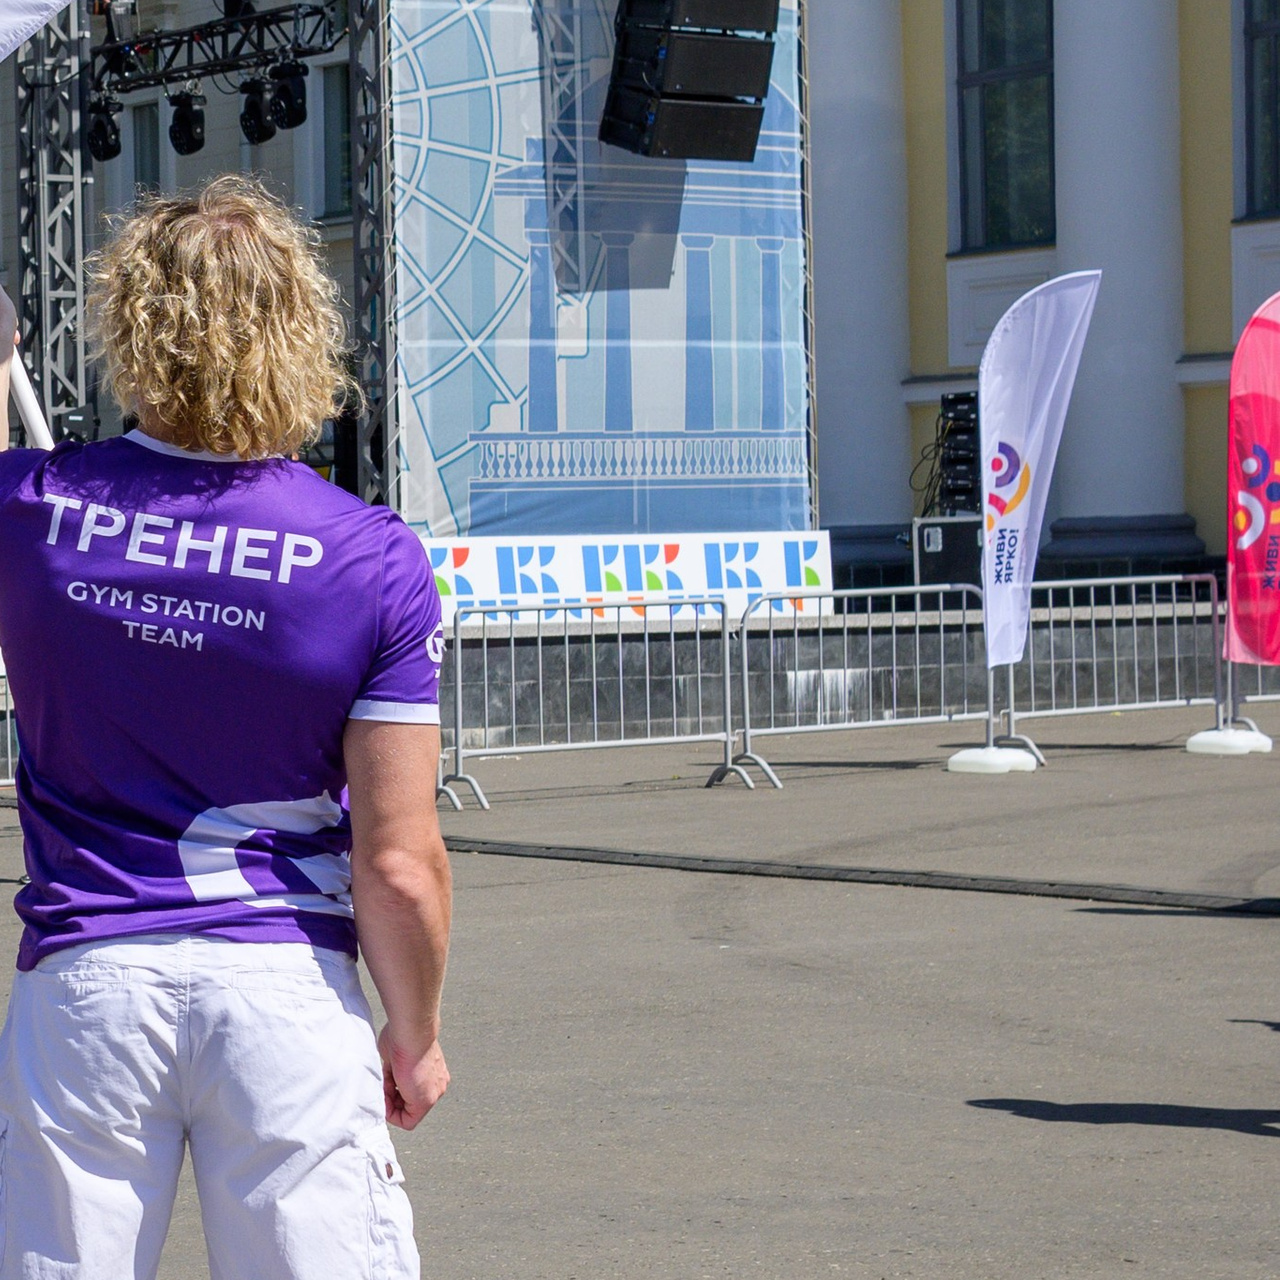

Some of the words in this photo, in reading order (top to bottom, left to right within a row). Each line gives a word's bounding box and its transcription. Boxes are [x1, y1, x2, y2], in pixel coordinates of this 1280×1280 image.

[42, 493, 324, 584] ТРЕНЕР
[994, 528, 1007, 584] ЖИВИ
[1004, 529, 1019, 584] ЯРКО!
[67, 581, 133, 610] GYM
[140, 593, 266, 631] STATION
[122, 620, 204, 652] TEAM
